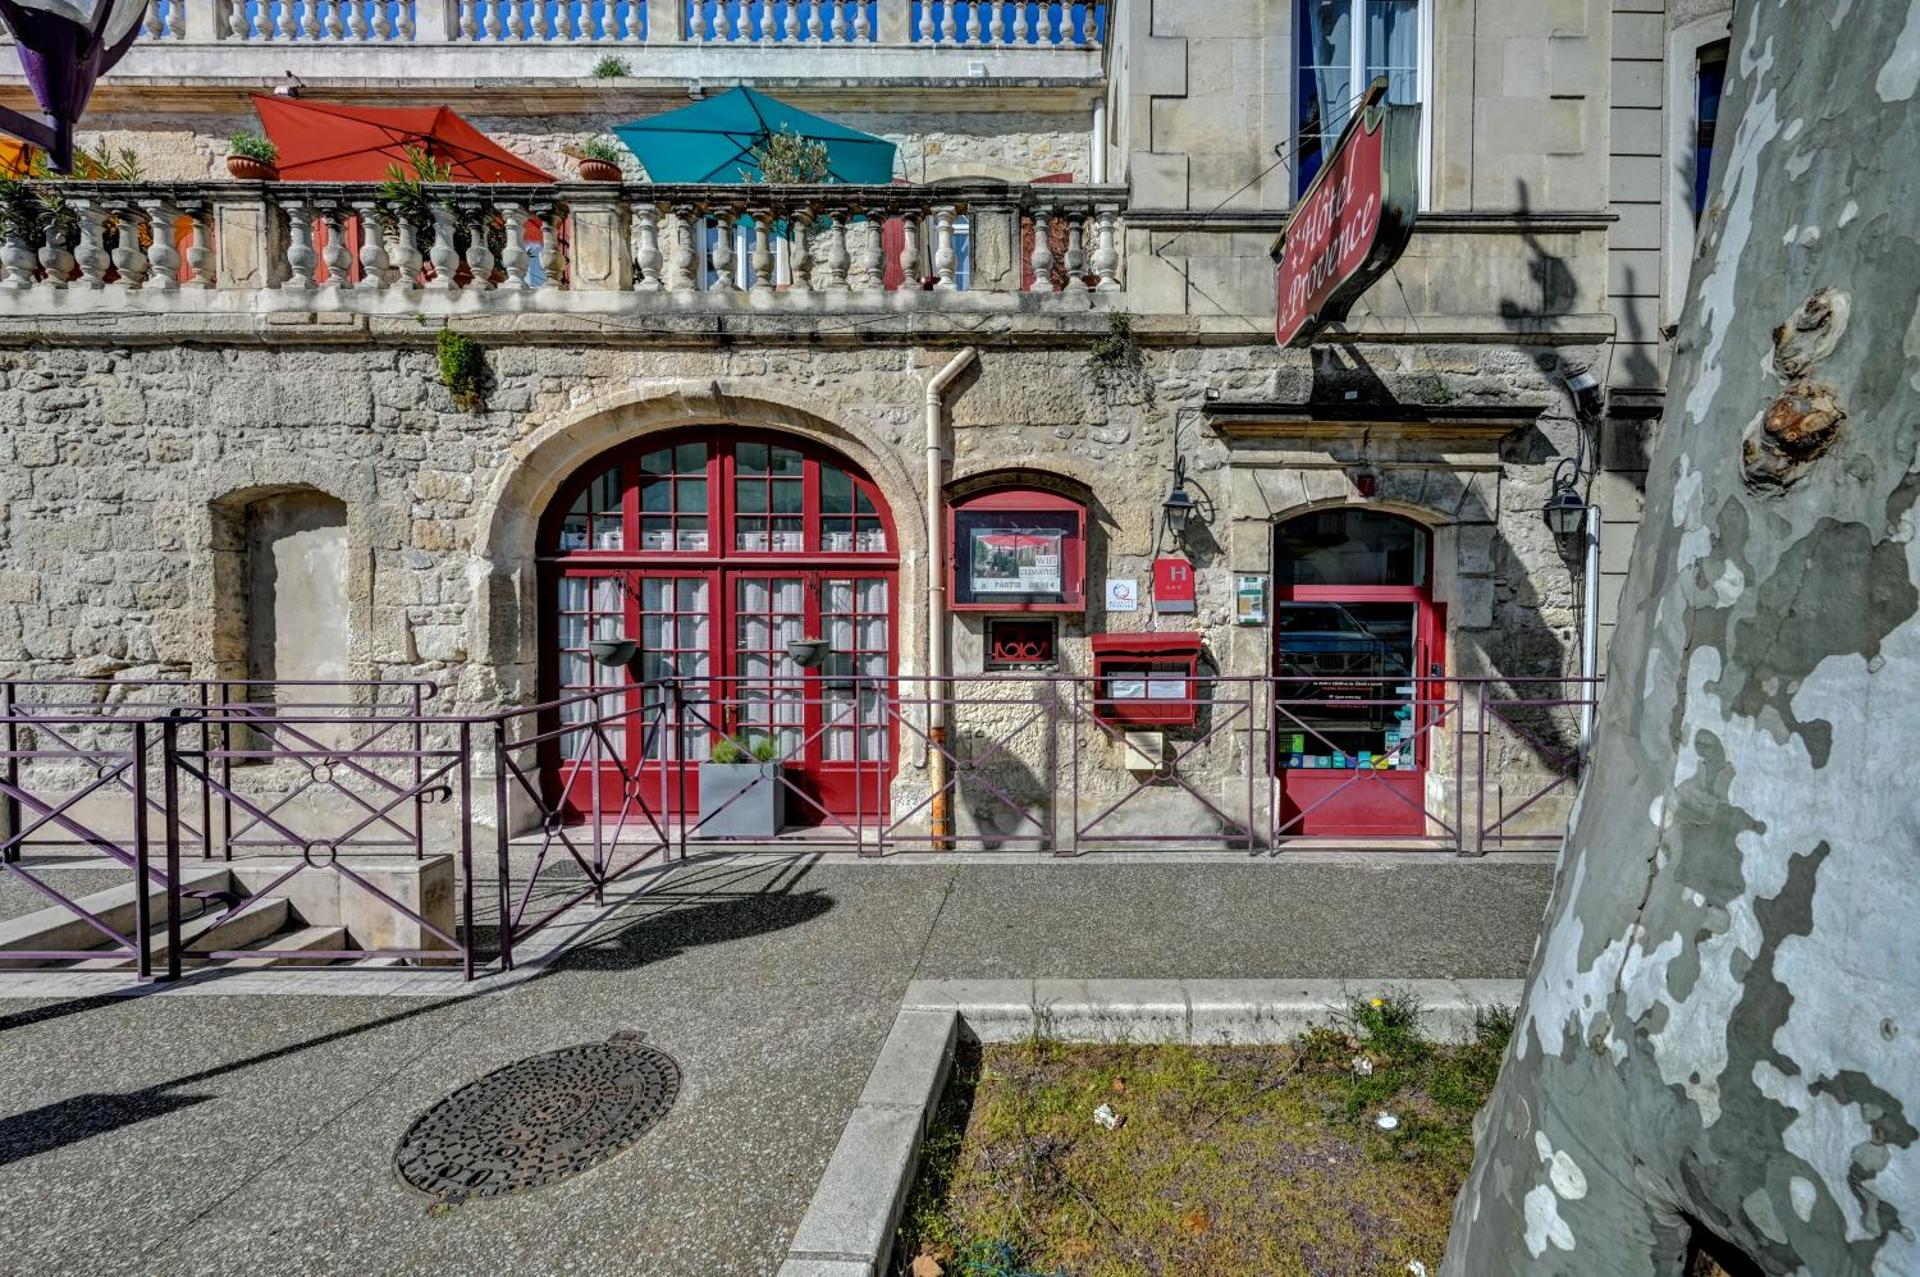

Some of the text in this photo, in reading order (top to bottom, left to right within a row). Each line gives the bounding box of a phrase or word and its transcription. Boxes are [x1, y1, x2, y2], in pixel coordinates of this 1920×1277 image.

[1288, 193, 1375, 321] Provence
[1300, 134, 1361, 263] Hôtel
[1170, 566, 1187, 582] H
